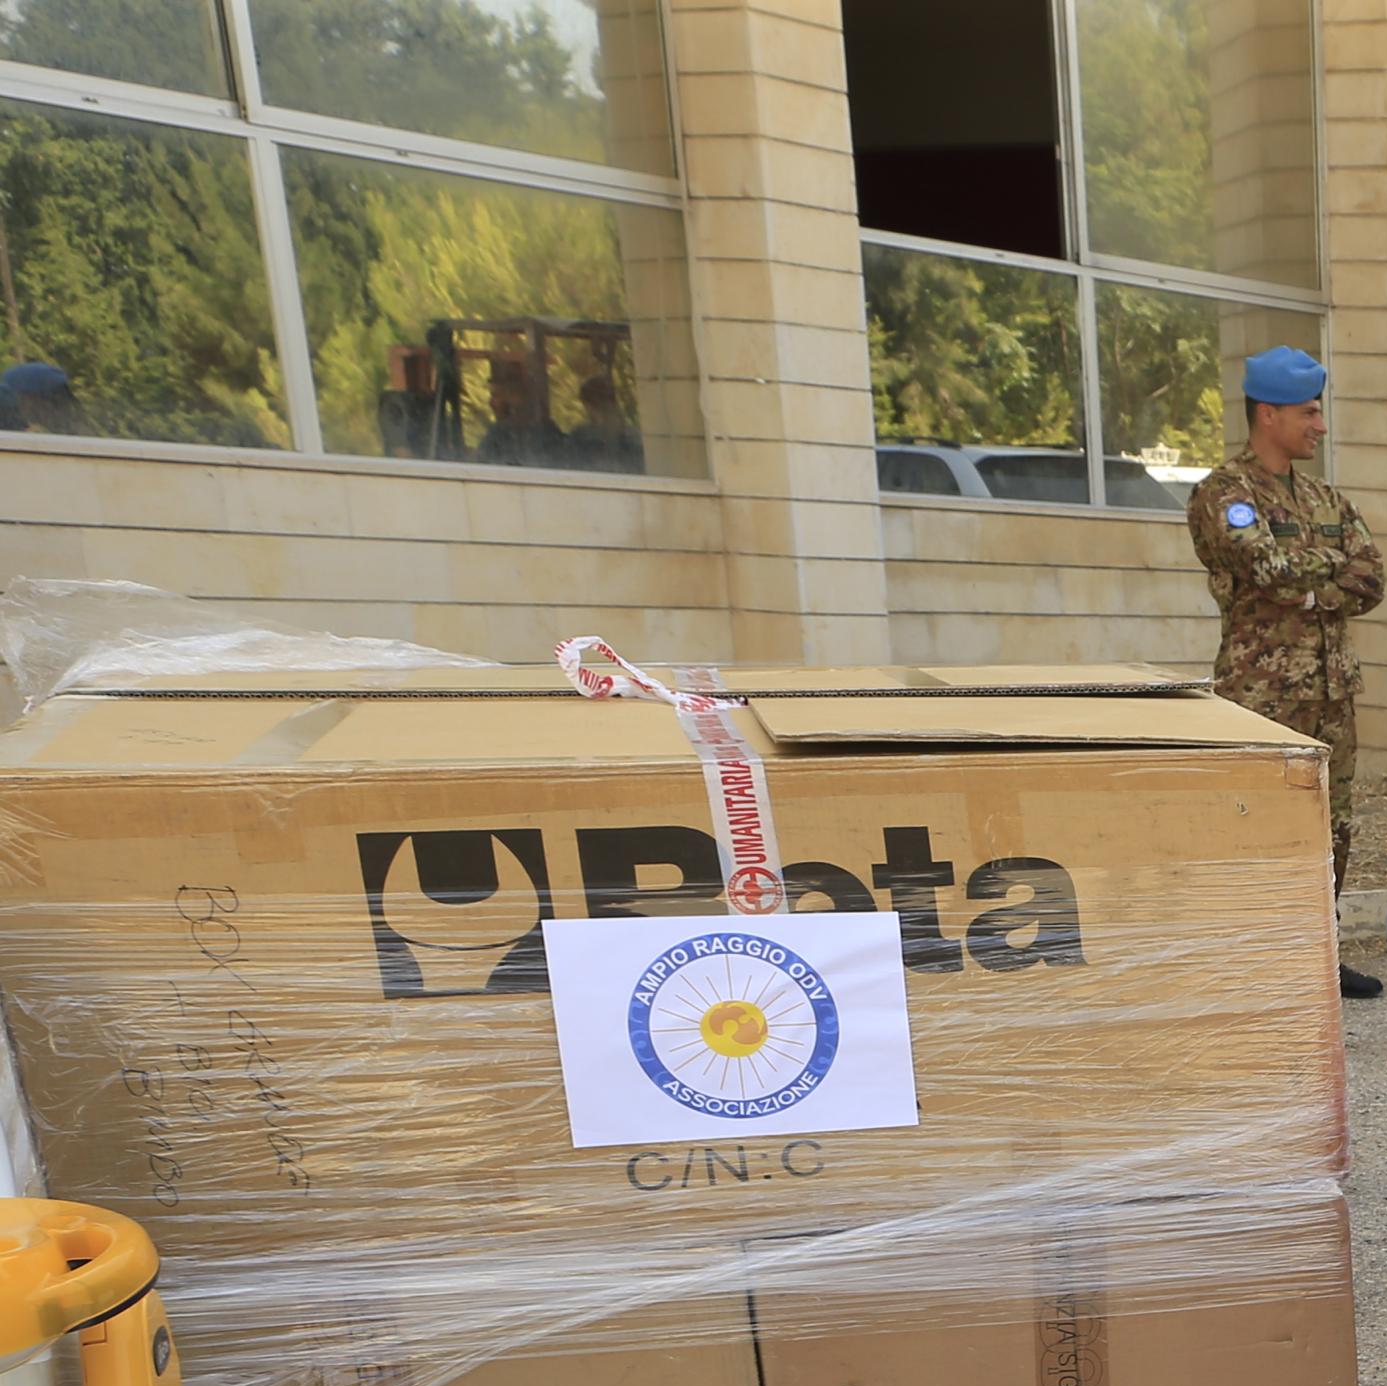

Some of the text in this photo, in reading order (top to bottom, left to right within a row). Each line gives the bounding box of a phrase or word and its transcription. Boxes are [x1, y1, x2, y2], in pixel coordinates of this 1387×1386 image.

[717, 759, 768, 865] UMANITARIA
[174, 884, 257, 992] BOX
[634, 936, 828, 1007] AMPIO RAGGIO ODV
[662, 1070, 818, 1116] ASSOCIAZIONE
